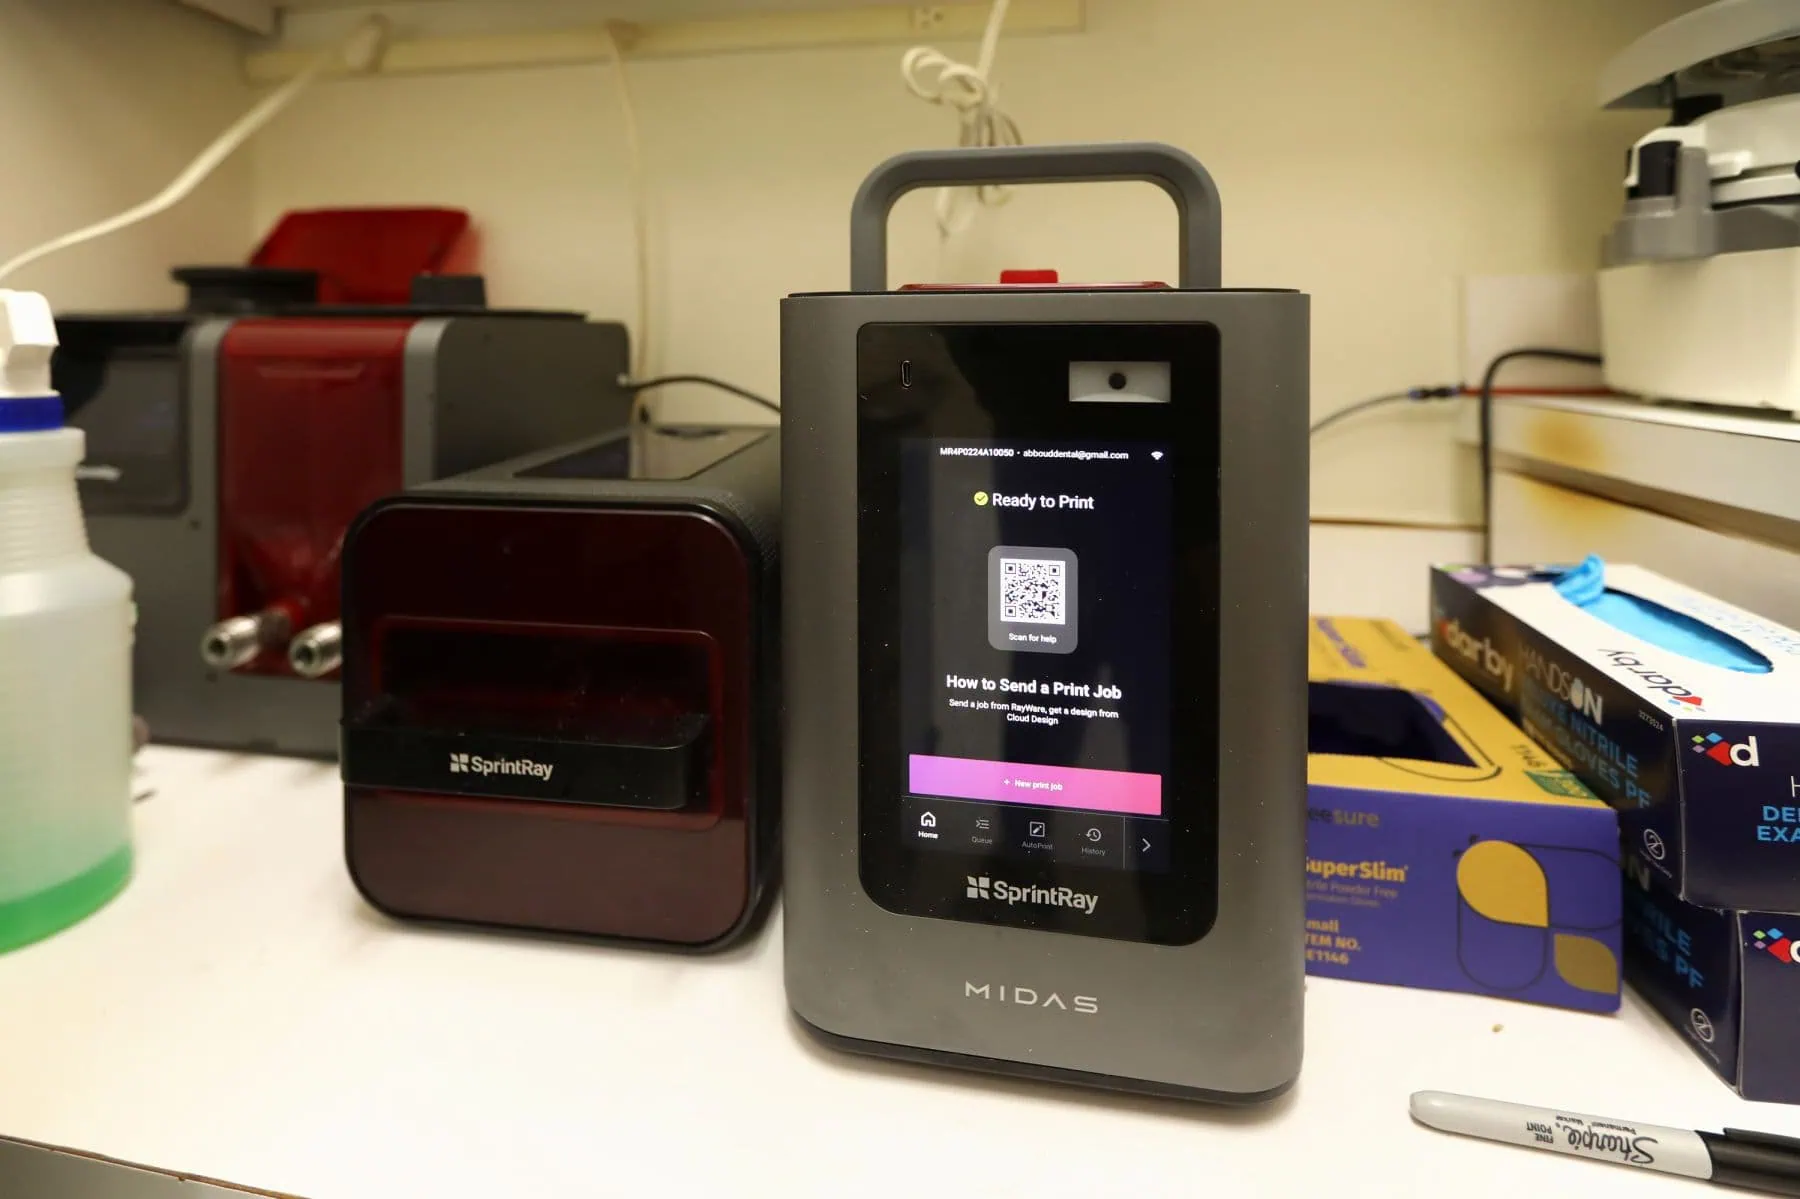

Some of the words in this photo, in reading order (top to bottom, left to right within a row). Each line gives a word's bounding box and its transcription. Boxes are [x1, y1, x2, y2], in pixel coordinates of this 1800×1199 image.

[1023, 450, 1129, 460] abbouddental@gmail.com
[992, 492, 1036, 511] Ready
[1040, 495, 1055, 508] to
[1059, 494, 1095, 509] Print
[1008, 632, 1028, 641] Scan
[1029, 633, 1039, 642] for
[1040, 634, 1057, 644] help
[1446, 619, 1514, 692] darby
[1597, 648, 1693, 696] darby
[946, 674, 978, 690] How
[981, 677, 996, 691] to
[999, 678, 1037, 694] Send
[1040, 683, 1049, 695] a
[1053, 681, 1090, 698] Print
[1093, 684, 1122, 700] Job
[948, 698, 969, 708] Send
[970, 701, 975, 709] a
[976, 700, 989, 710] job
[991, 701, 1009, 711] from
[1011, 703, 1047, 715] RayWare,
[1049, 706, 1062, 715] get
[1070, 707, 1097, 718] design
[1099, 708, 1119, 719] from
[1006, 713, 1030, 723] Cloud
[1031, 715, 1059, 726] Design
[1571, 713, 1638, 777] NITRILE
[1729, 735, 1760, 767] d
[471, 755, 553, 781] SprintRay
[1014, 779, 1032, 788] New
[1032, 780, 1049, 791] print
[1050, 781, 1063, 791] job
[1625, 776, 1652, 809] PF
[1762, 805, 1800, 823] DE
[918, 830, 938, 840] Home
[971, 836, 993, 845] Queue
[1022, 840, 1053, 850] AutoPrint
[1081, 846, 1106, 857] History
[1306, 856, 1406, 883] uperSlim
[993, 880, 1099, 915] SprintRay
[1306, 919, 1339, 933] mall
[1305, 934, 1332, 947] TEM
[1305, 949, 1349, 965] E1146
[965, 980, 1098, 1014] MIDAS
[1527, 1121, 1553, 1134] POINT
[1535, 1133, 1554, 1144] FINE
[1563, 1125, 1658, 1164] Sharpie
